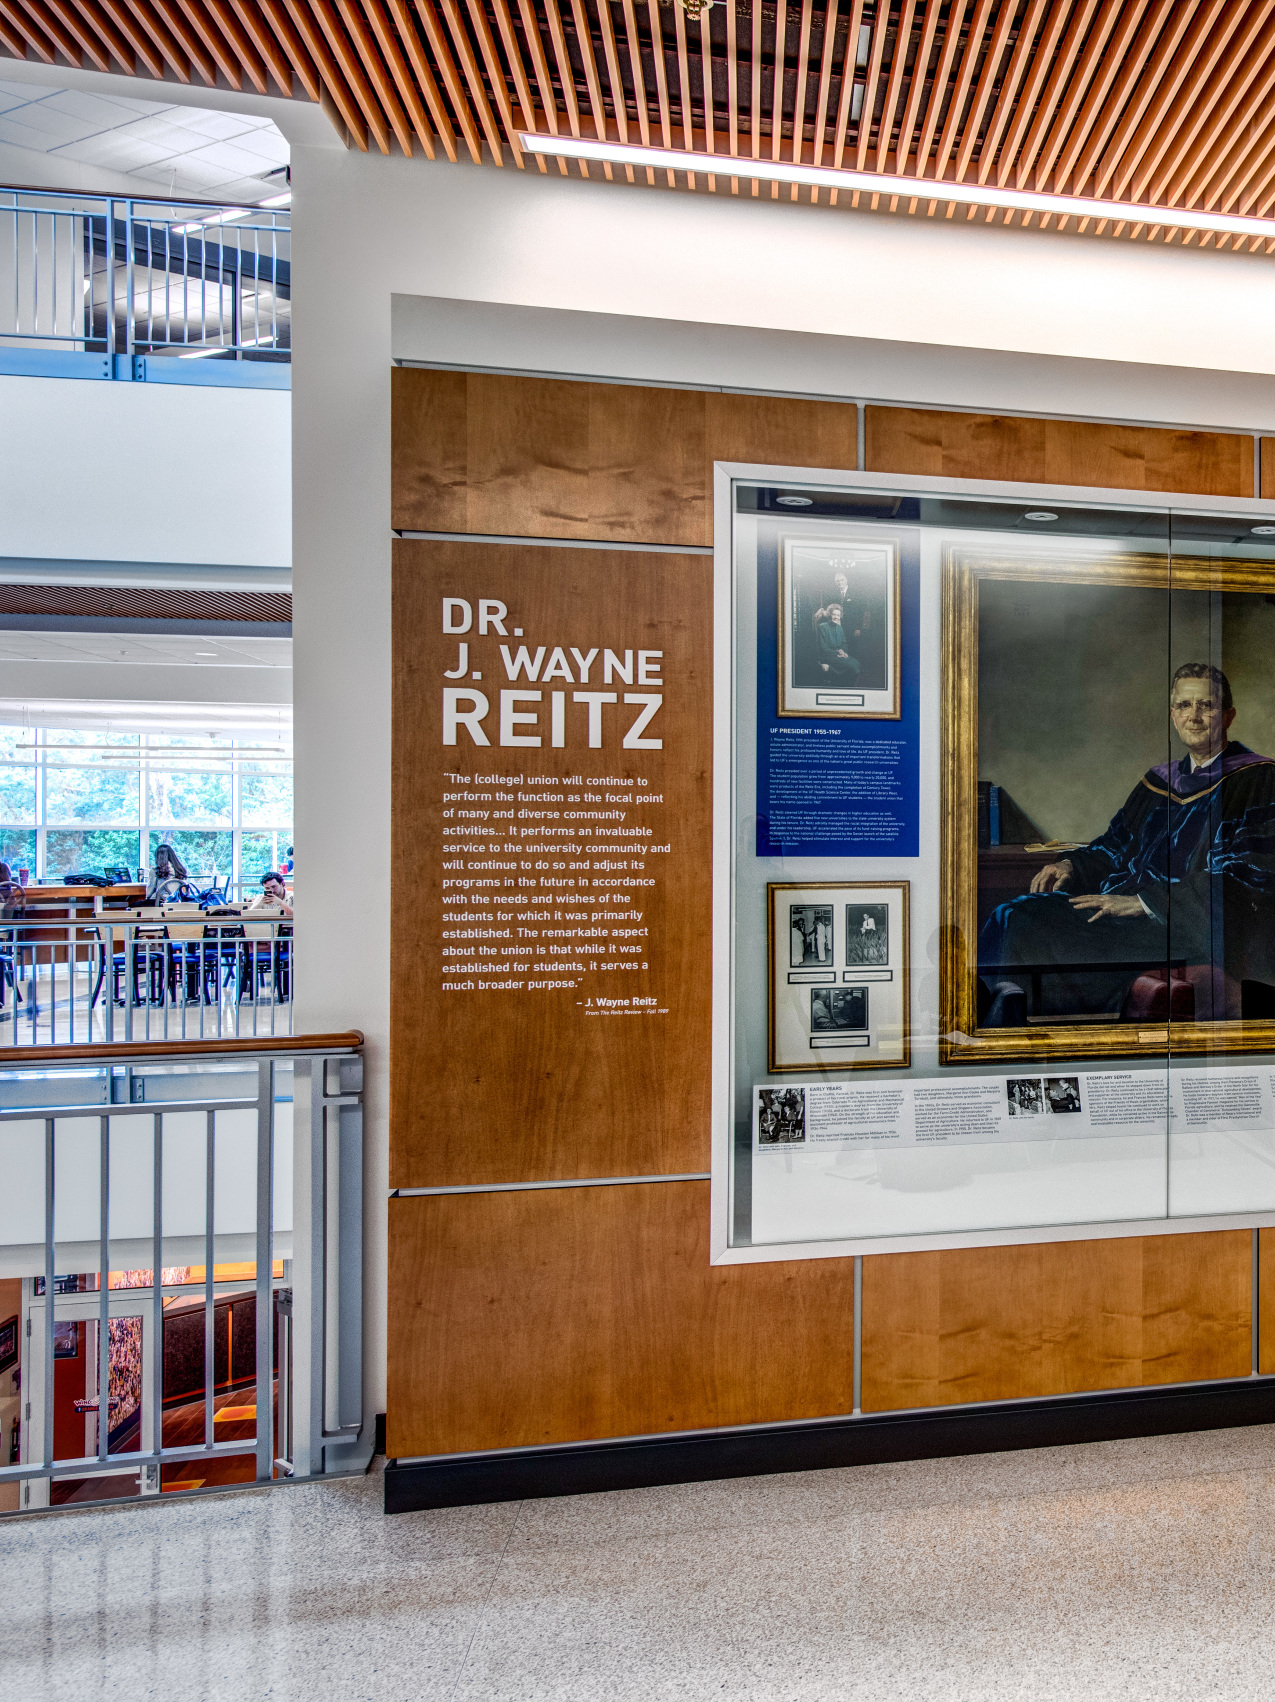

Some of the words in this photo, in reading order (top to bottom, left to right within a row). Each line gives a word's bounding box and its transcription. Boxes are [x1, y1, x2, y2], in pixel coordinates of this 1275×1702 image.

[443, 597, 523, 636] DR.
[443, 642, 481, 680] J.
[499, 644, 663, 685] WAYNE
[443, 687, 662, 749] REITZ
[475, 773, 523, 787] (college)
[527, 775, 558, 785] union
[562, 775, 583, 785] will
[586, 776, 634, 786] continue
[637, 777, 648, 786] to
[443, 791, 492, 803] perform
[495, 791, 514, 801] the
[517, 791, 564, 802] function
[567, 794, 580, 802] as
[584, 792, 602, 802] the
[605, 792, 633, 802] focal
[636, 793, 663, 805] point
[443, 808, 454, 817] of
[458, 810, 490, 820] many
[493, 808, 514, 818] and
[518, 808, 560, 819] diverse
[563, 809, 626, 821] community
[443, 825, 505, 835] activities...
[509, 825, 517, 835] It
[521, 825, 575, 838] performs
[596, 826, 652, 836] invaluable
[443, 842, 485, 852] service
[489, 843, 500, 852] to
[504, 842, 522, 852] the
[526, 842, 582, 855] university
[585, 843, 648, 855] community
[650, 843, 670, 853] and
[442, 859, 464, 869] will
[467, 859, 517, 869] continue
[520, 860, 531, 869] to
[535, 859, 549, 869] do
[569, 860, 589, 869] and
[593, 859, 627, 872] adjust
[631, 859, 645, 869] its
[443, 879, 500, 889] programs
[504, 876, 514, 886] in
[518, 877, 536, 886] the
[540, 876, 575, 886] future
[578, 876, 588, 886] in
[592, 876, 655, 886] accordance
[442, 894, 467, 904] with
[471, 894, 490, 904] the
[493, 894, 528, 903] needs
[531, 893, 552, 903] and
[555, 893, 595, 903] wishes
[598, 893, 610, 903] of
[613, 893, 630, 903] the
[442, 911, 493, 921] students
[497, 911, 514, 921] for
[517, 910, 550, 920] which
[554, 910, 562, 920] it
[565, 912, 588, 920] was
[591, 910, 643, 922] primarily
[442, 928, 513, 938] established.
[517, 928, 538, 937] The
[542, 927, 608, 937] remarkable
[611, 927, 648, 938] aspect
[442, 946, 475, 956] about
[479, 945, 497, 955] the
[501, 945, 532, 955] union
[536, 944, 546, 954] is
[549, 944, 572, 954] that
[574, 943, 605, 954] while
[609, 943, 616, 953] it
[619, 945, 642, 953] was
[442, 962, 509, 973] established
[513, 962, 530, 972] for
[533, 961, 586, 972] students,
[590, 960, 597, 970] it
[600, 962, 638, 970] serves
[442, 980, 474, 990] much
[478, 979, 525, 989] broader
[584, 998, 593, 1007] J.
[596, 997, 630, 1008] Wayne
[632, 996, 657, 1006] Reitz
